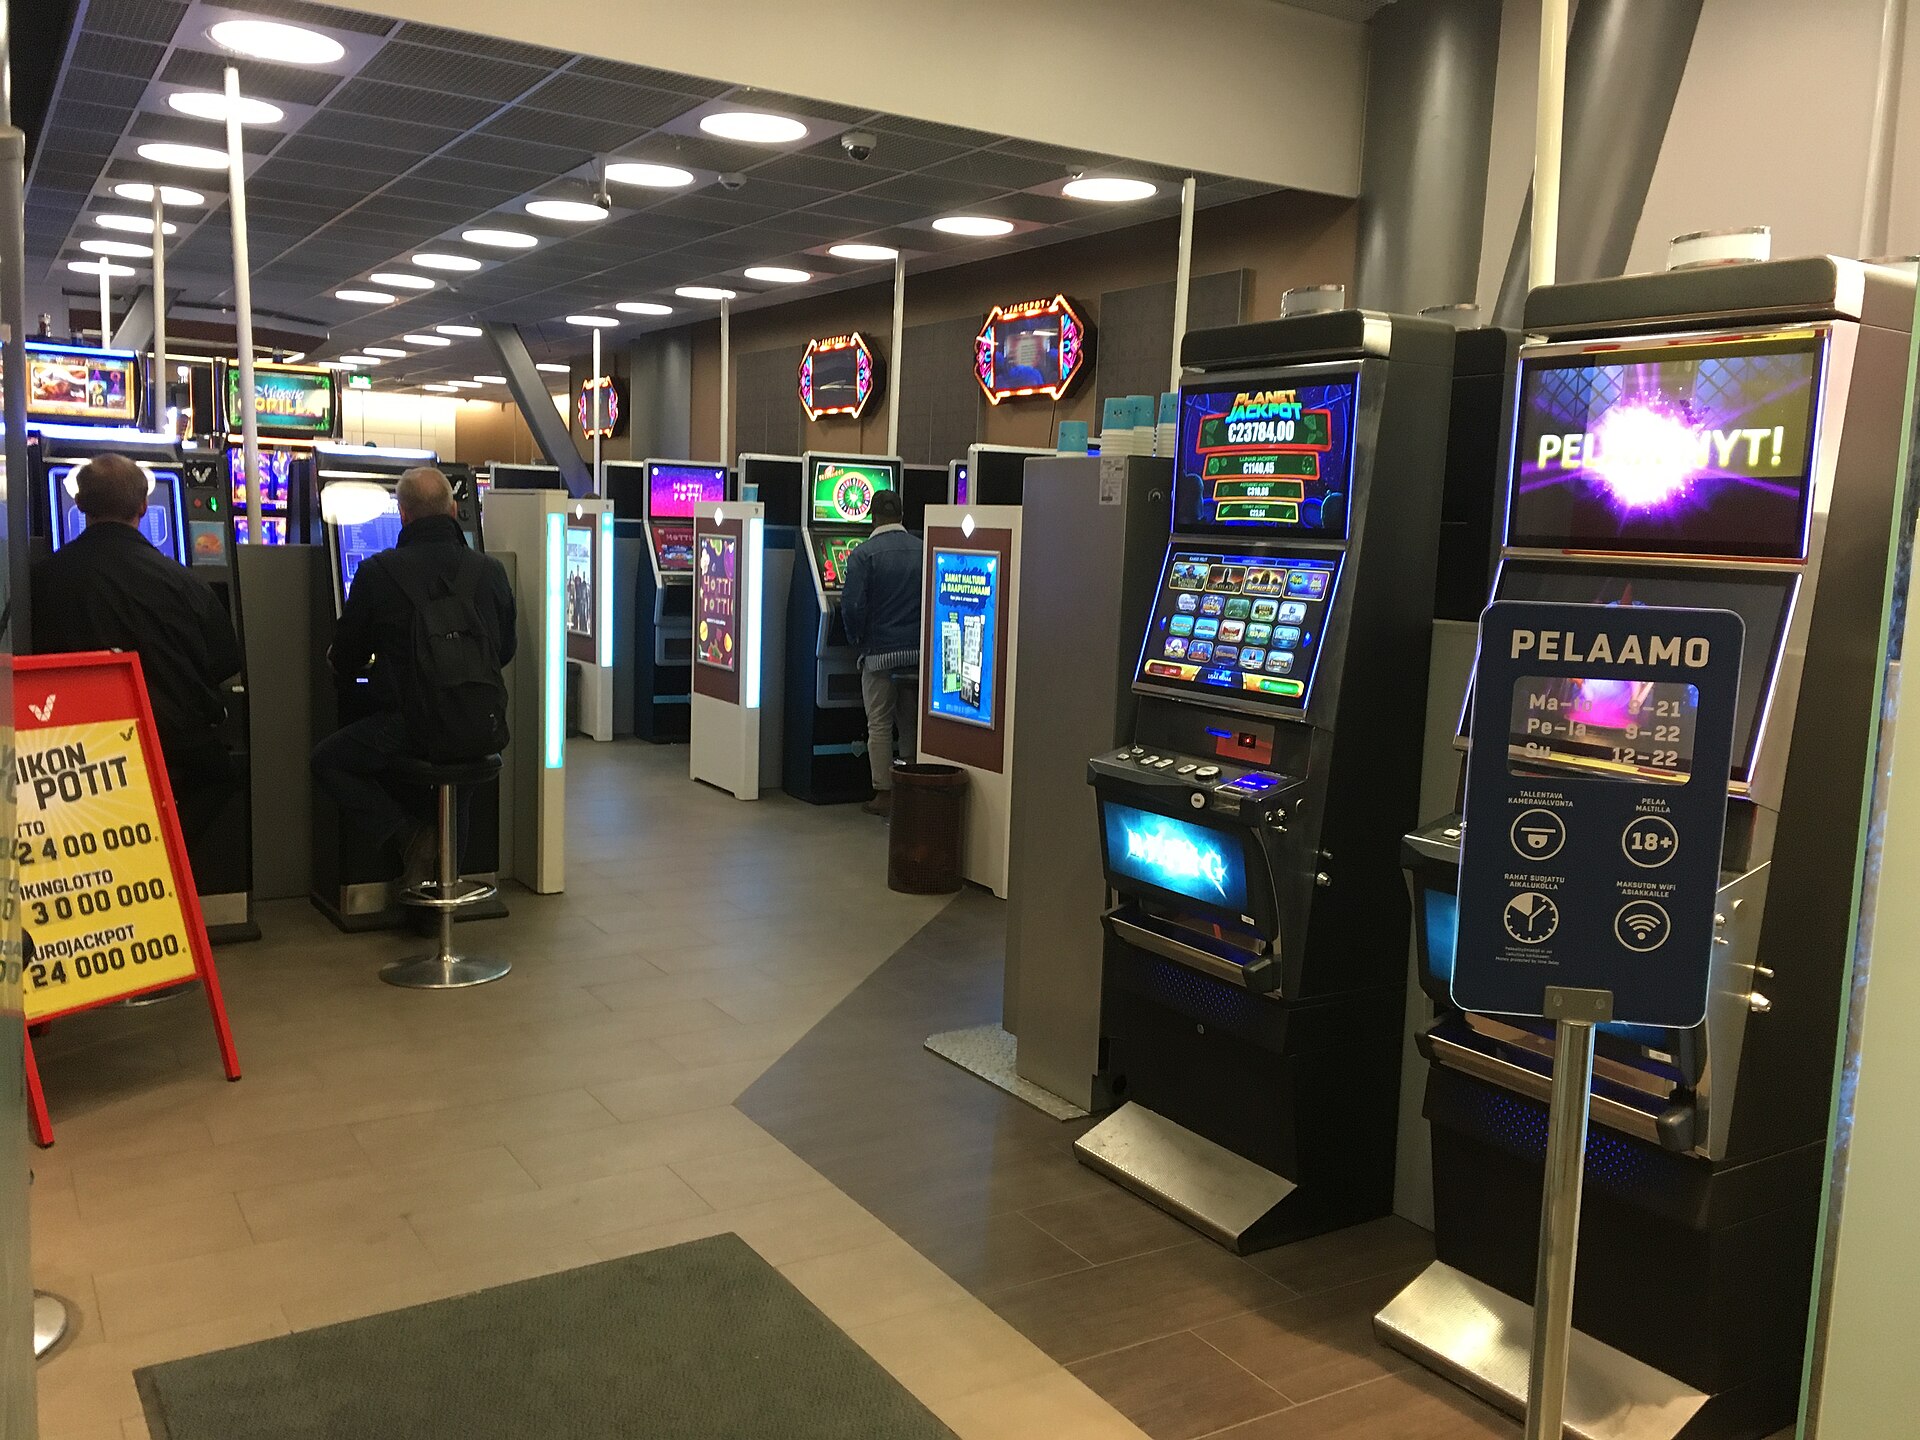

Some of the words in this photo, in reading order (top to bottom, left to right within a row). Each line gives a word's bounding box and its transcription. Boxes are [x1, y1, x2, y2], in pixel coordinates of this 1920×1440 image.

[1009, 299, 1046, 313] JACKPOT
[1234, 389, 1296, 406] PLANET
[1225, 402, 1302, 424] JACKPOT
[1697, 425, 1785, 469] YT!
[673, 492, 702, 503] POTTI
[1511, 629, 1710, 668] PELAAMO
[1525, 742, 1551, 759] Su
[16, 741, 86, 786] IKON
[33, 756, 128, 811] POTIT
[1508, 797, 1574, 807] KAMERAVALVONTA
[1520, 790, 1563, 800] TALLENTAVA
[1641, 797, 1666, 806] PELAA
[1635, 805, 1671, 813] MALTILLA
[17, 821, 45, 839] TTO
[1631, 832, 1673, 851] 18+
[20, 869, 114, 901] IKINGLOTTO
[1504, 873, 1528, 882] RAHAT
[1530, 874, 1565, 884] SUOJATTU
[1509, 881, 1559, 890] AIKALUKOLLA
[1616, 881, 1657, 890] MAKSUTON
[1621, 888, 1670, 898] ASIAKKAILLE
[30, 923, 135, 963] UROJACKPOT
